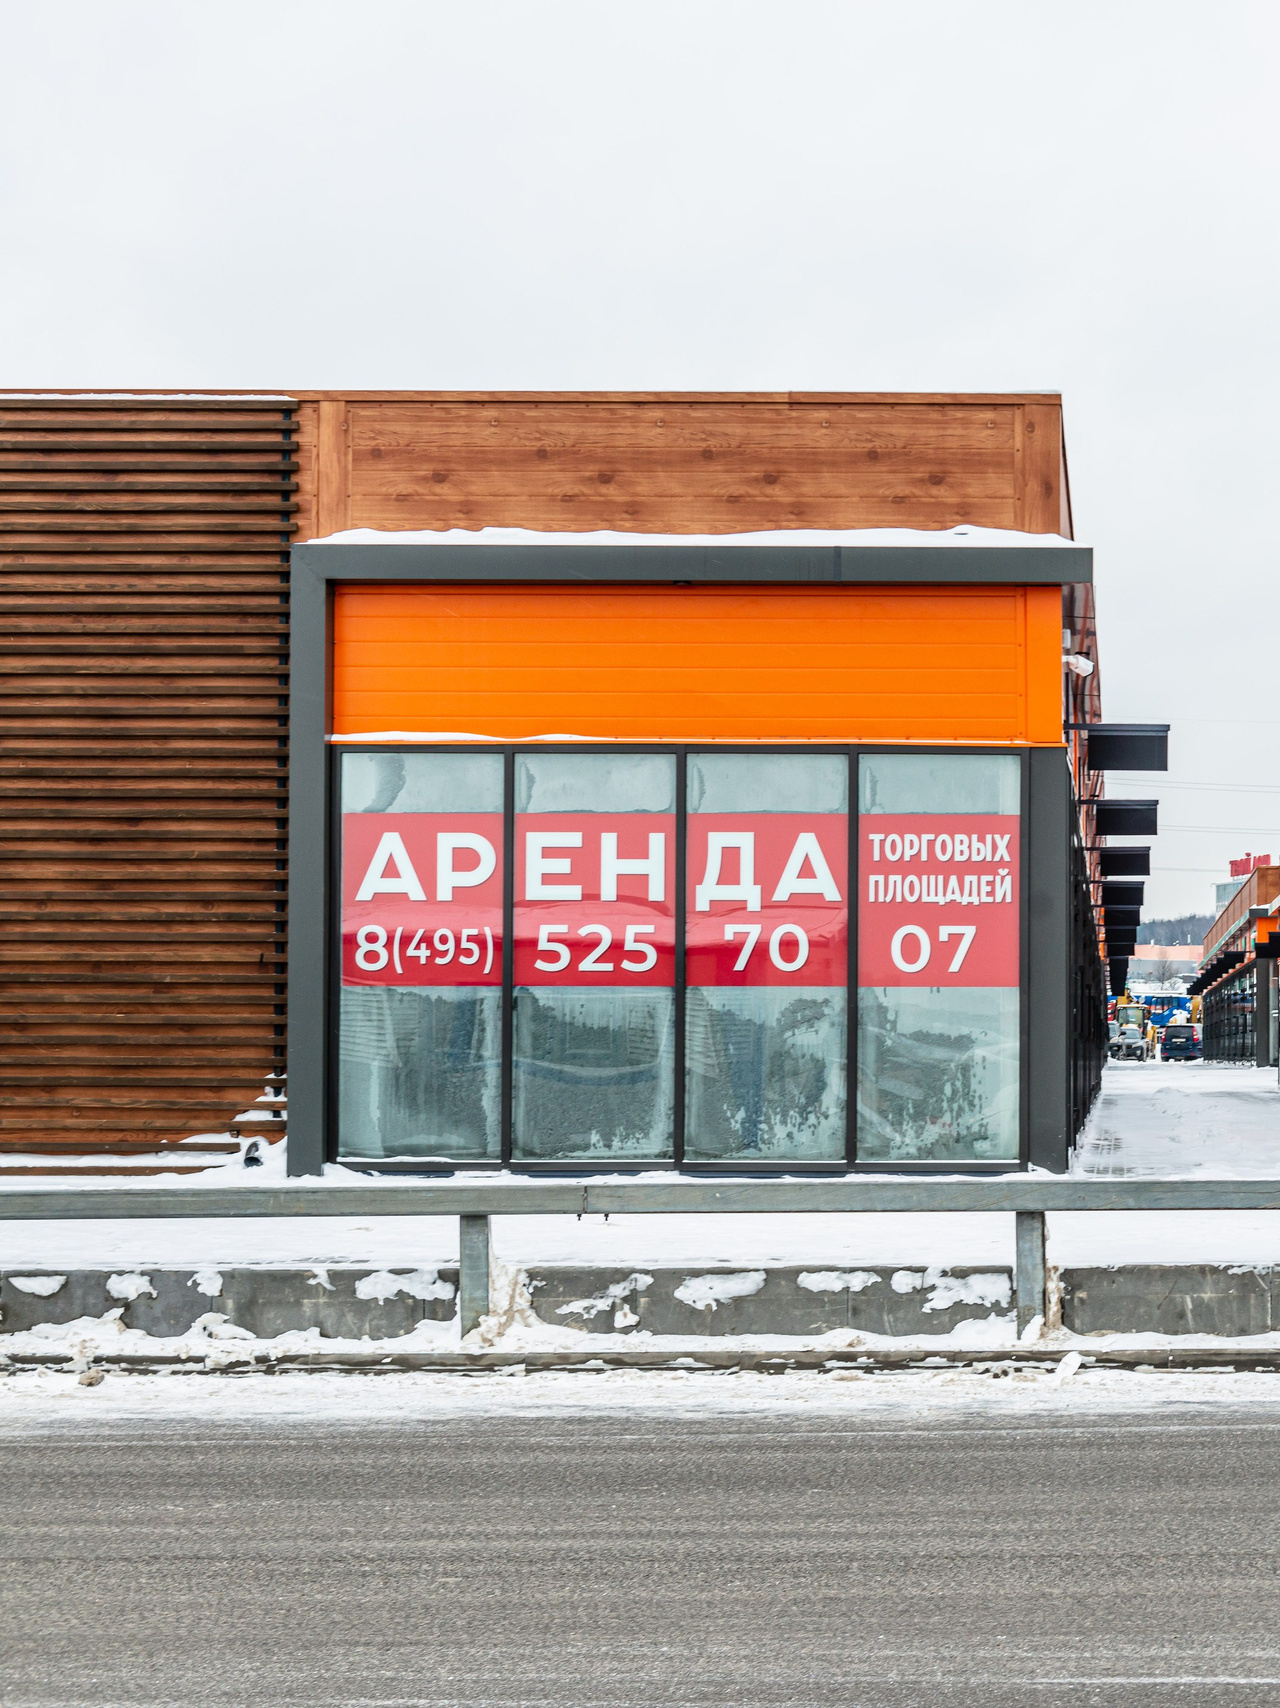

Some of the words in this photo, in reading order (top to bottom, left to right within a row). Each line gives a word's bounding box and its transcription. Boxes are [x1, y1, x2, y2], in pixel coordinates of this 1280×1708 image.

[868, 833, 1012, 862] ТОРГОВЫХ
[355, 832, 842, 912] АРЕНДА
[868, 867, 1012, 906] ПЛОЩАДЕЙ
[355, 923, 494, 974] 8(495)
[535, 923, 658, 972] 525
[723, 922, 810, 972] 70
[890, 924, 977, 974] 07
